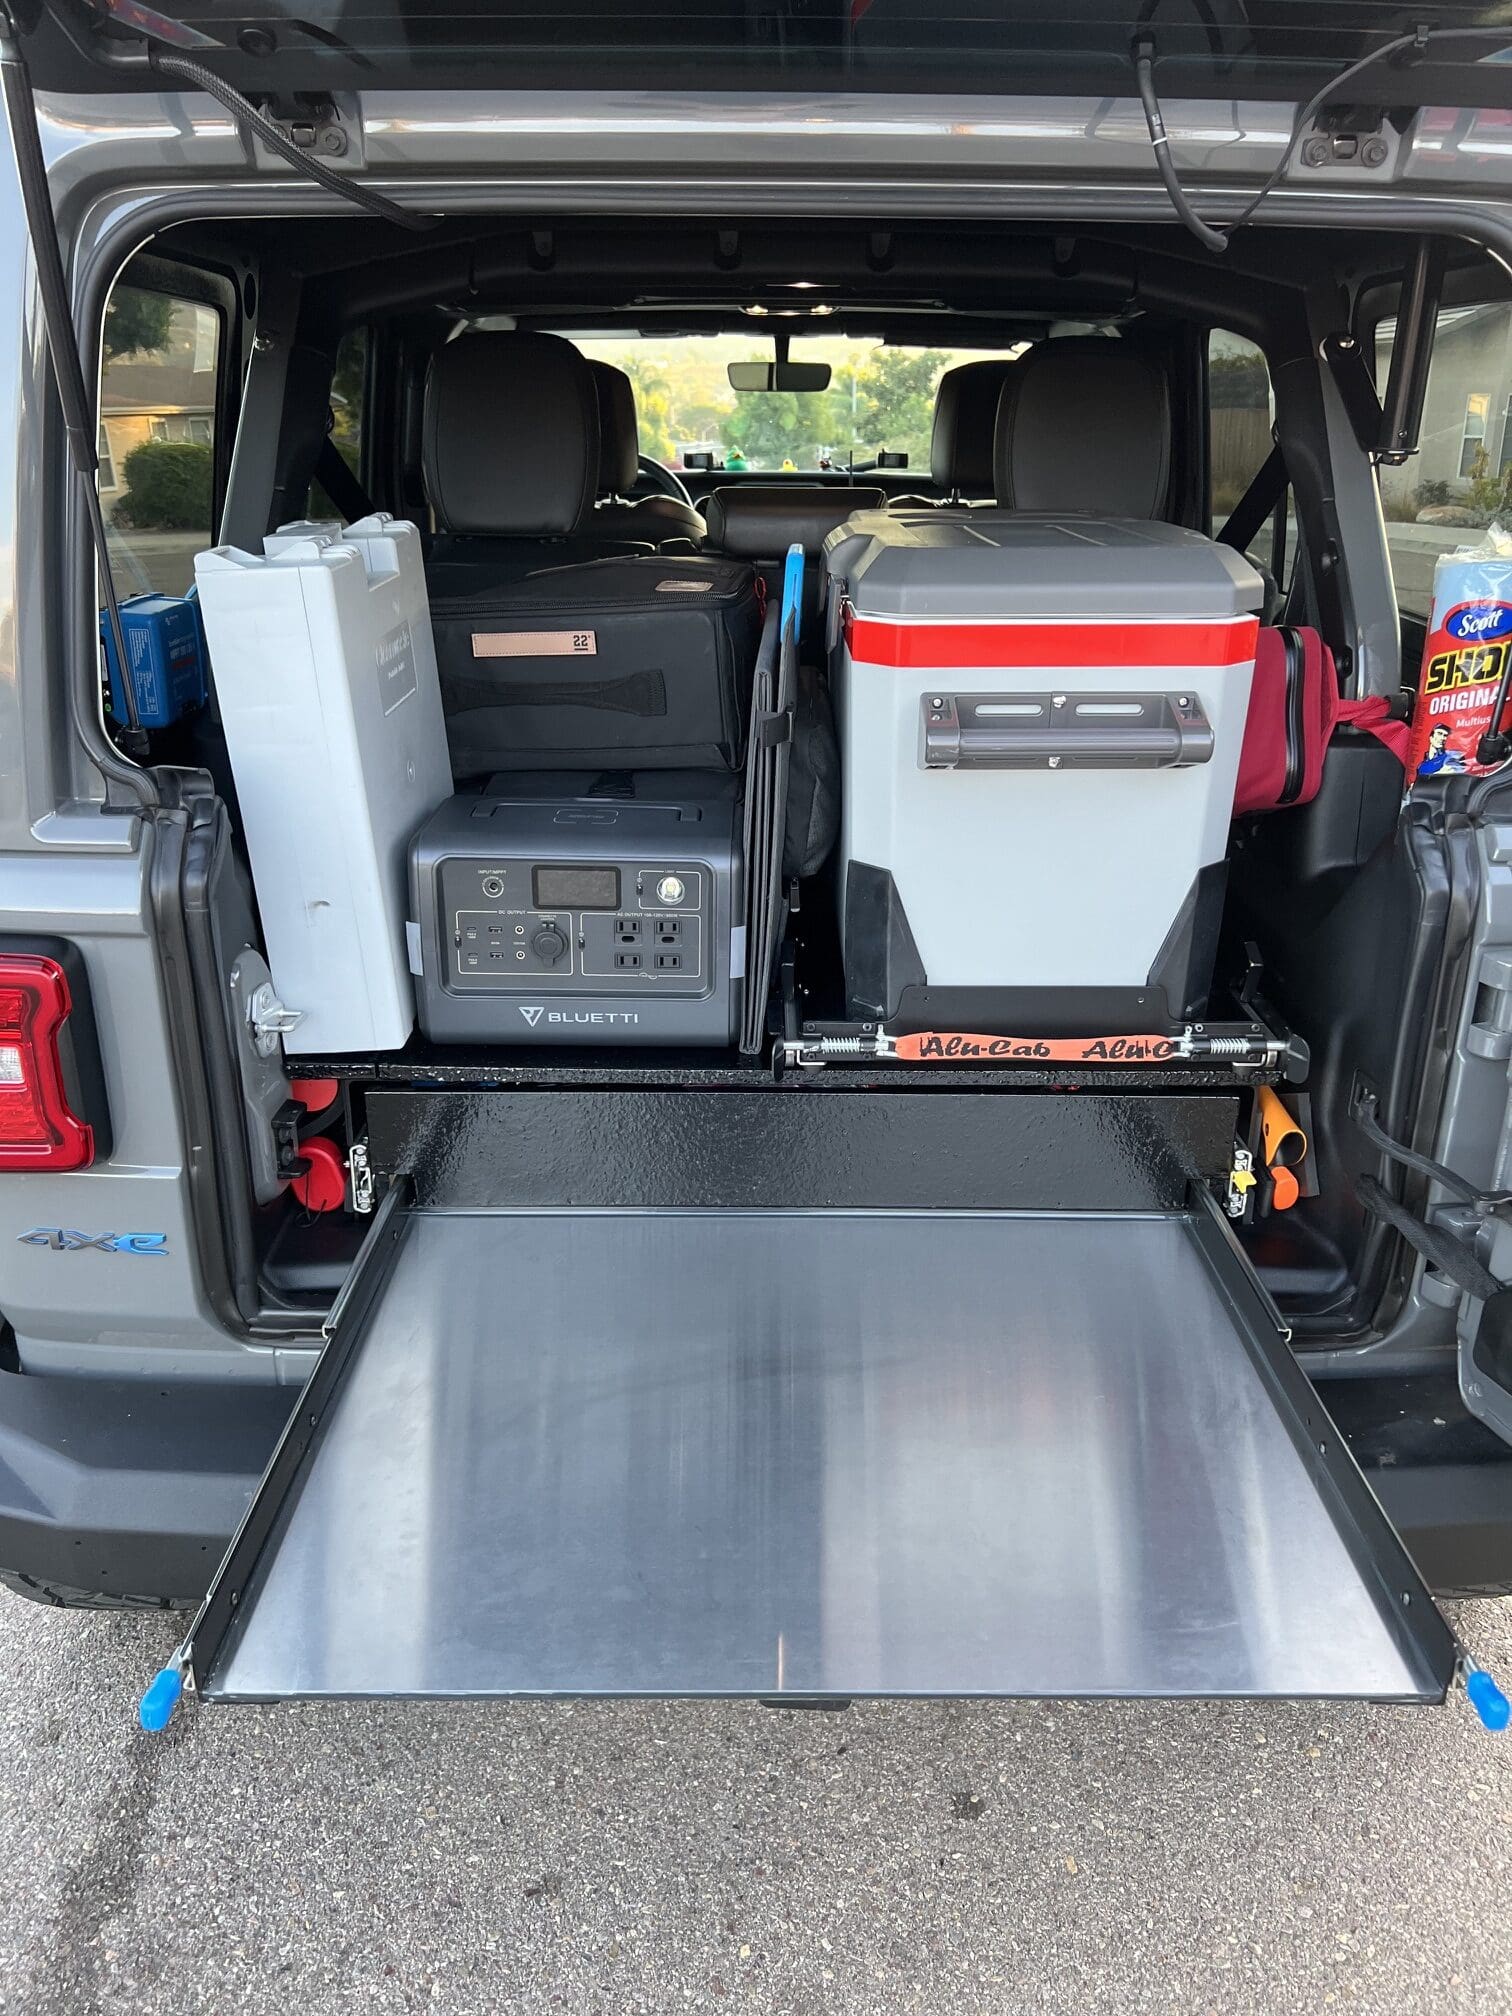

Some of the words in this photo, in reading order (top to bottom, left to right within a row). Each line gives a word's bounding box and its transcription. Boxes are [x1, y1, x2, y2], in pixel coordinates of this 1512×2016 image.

[1457, 609, 1504, 637] Scott
[1429, 687, 1511, 715] ORIGINA
[1456, 716, 1492, 728] Multius
[548, 1011, 639, 1024] BLUETTI
[920, 1036, 1050, 1058] Alu-Cab
